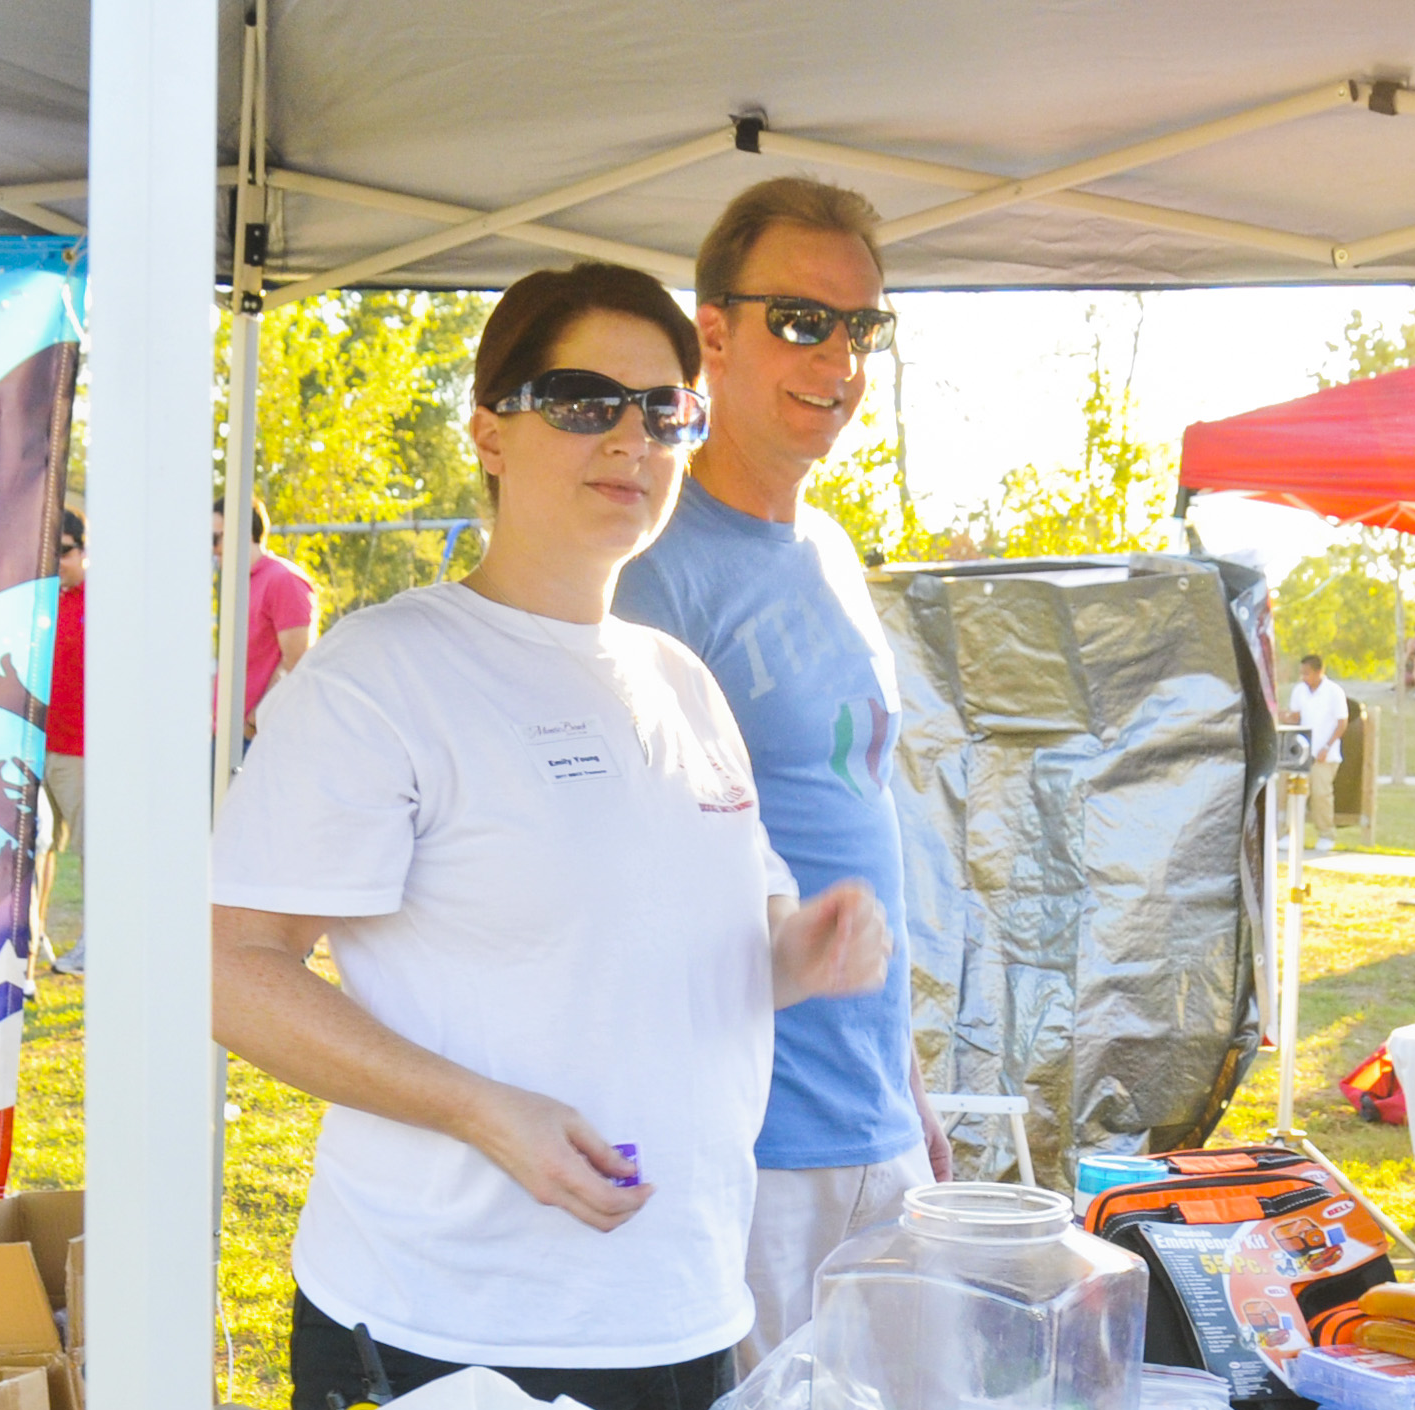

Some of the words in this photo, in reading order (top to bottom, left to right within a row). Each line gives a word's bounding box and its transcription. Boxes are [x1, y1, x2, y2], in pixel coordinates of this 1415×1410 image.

[1326, 1202, 1352, 1217] BELL
[1153, 1234, 1237, 1253] Emergency
[1245, 1234, 1269, 1250] Kit
[1199, 1254, 1232, 1275] 55
[1267, 1287, 1287, 1296] BELL
